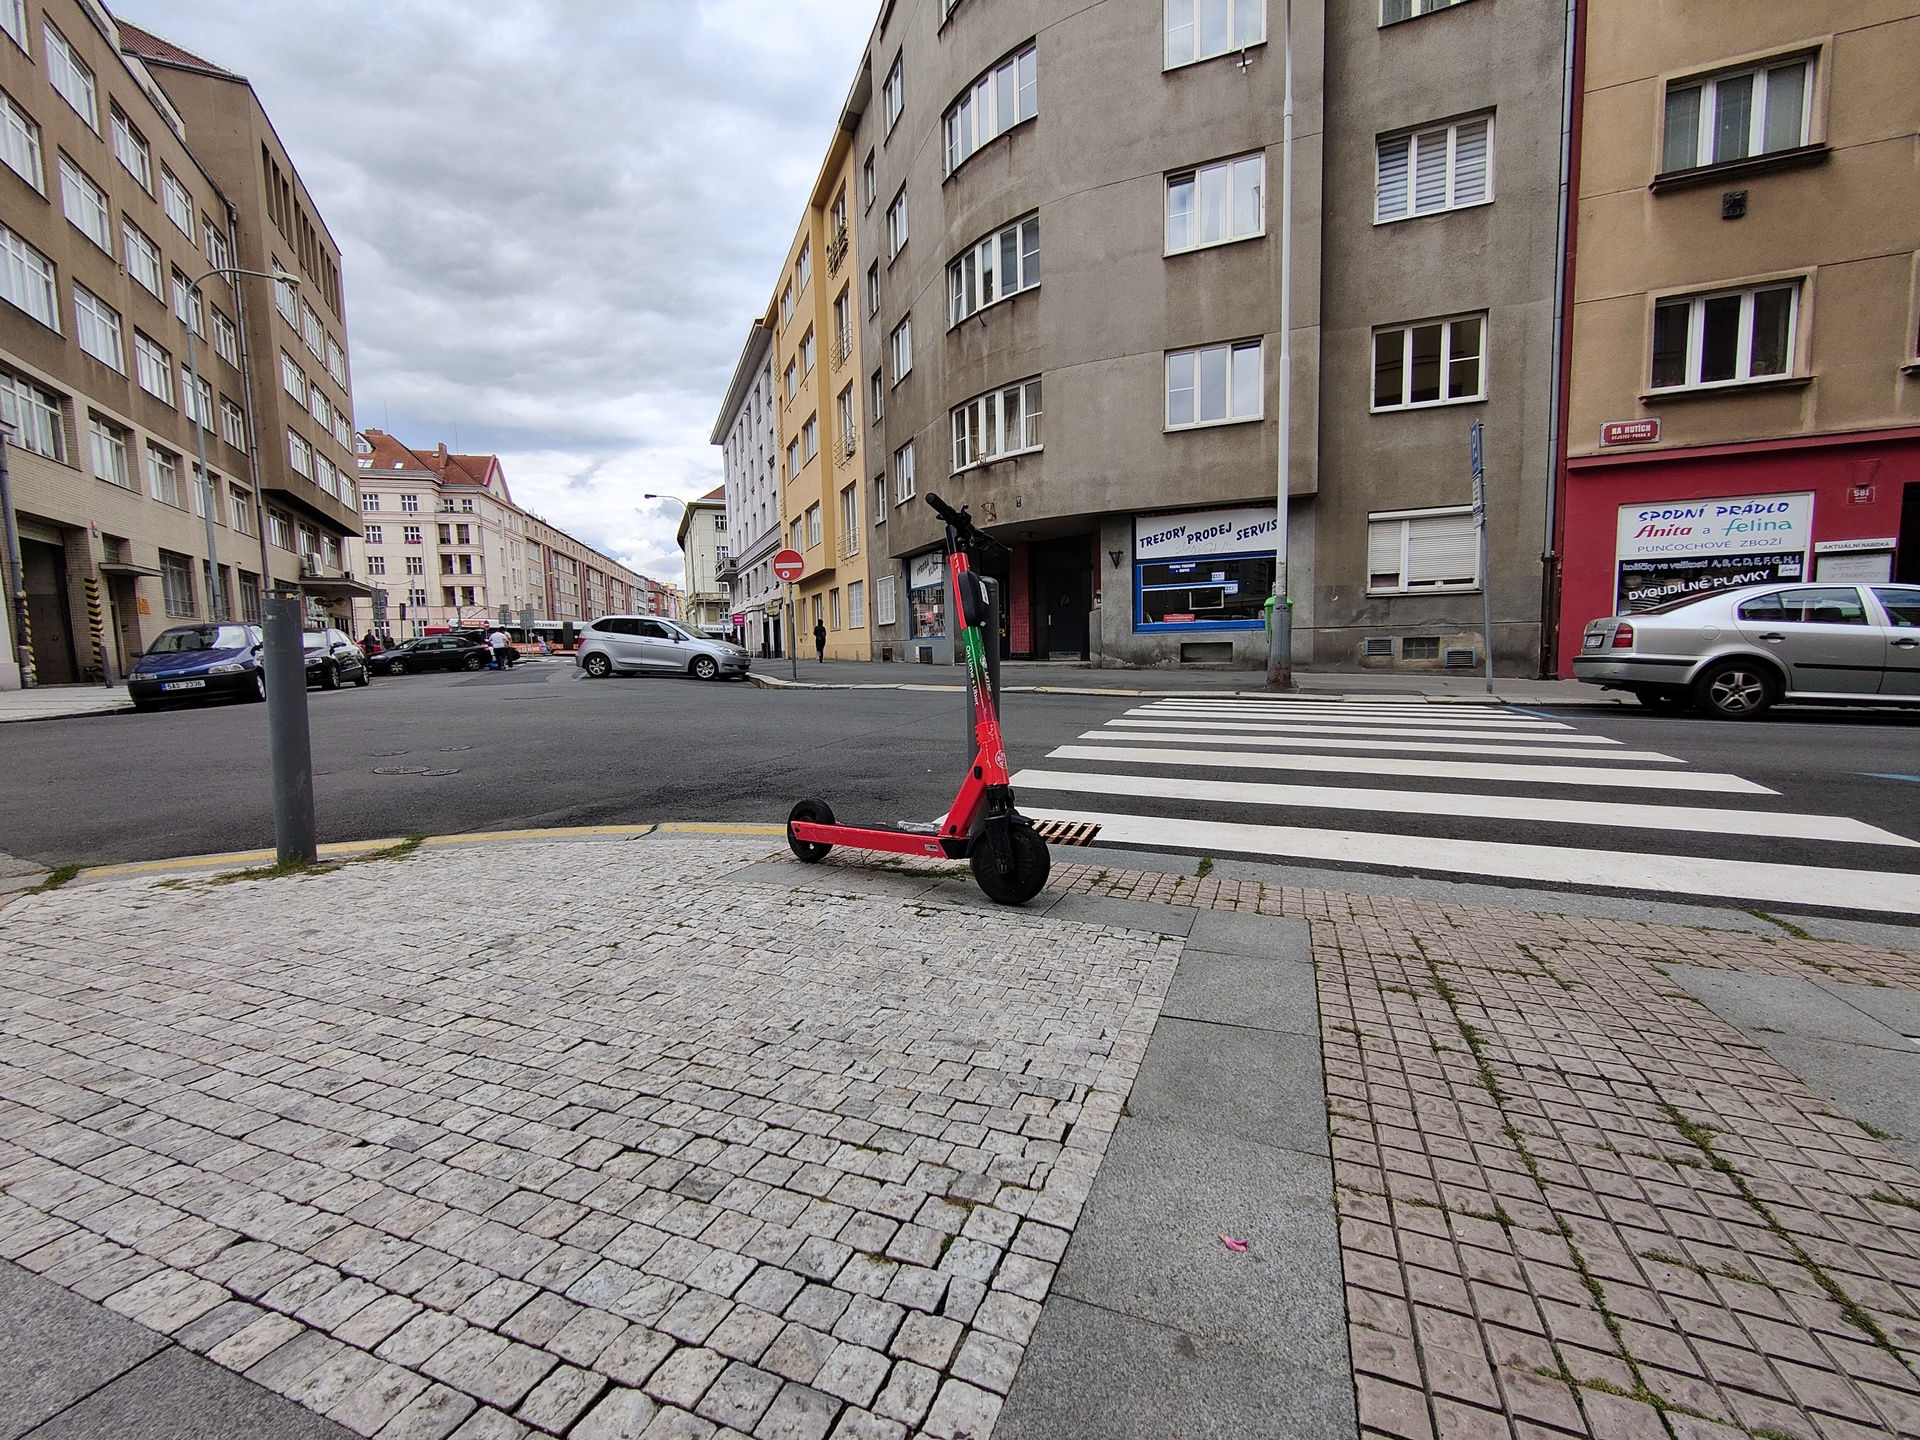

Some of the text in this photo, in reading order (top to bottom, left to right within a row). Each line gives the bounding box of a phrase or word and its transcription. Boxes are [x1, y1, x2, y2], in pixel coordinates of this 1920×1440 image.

[1611, 423, 1651, 435] NA HUTÍCH
[1853, 488, 1869, 497] 581
[1638, 500, 1790, 522] SPODNÍ PRÁDLO
[1139, 525, 1187, 548] TREZORY
[1186, 522, 1232, 544] PRODEJ
[1236, 519, 1277, 541] SERVIS
[1633, 517, 1793, 539] Anita a felina
[1637, 537, 1783, 553] PUNČOCHOVÉ ZBOŽÍ
[1628, 569, 1770, 601] DVOUDÍLNÉ PLAVKY
[965, 645, 972, 658] On
[967, 658, 975, 679] Lime
